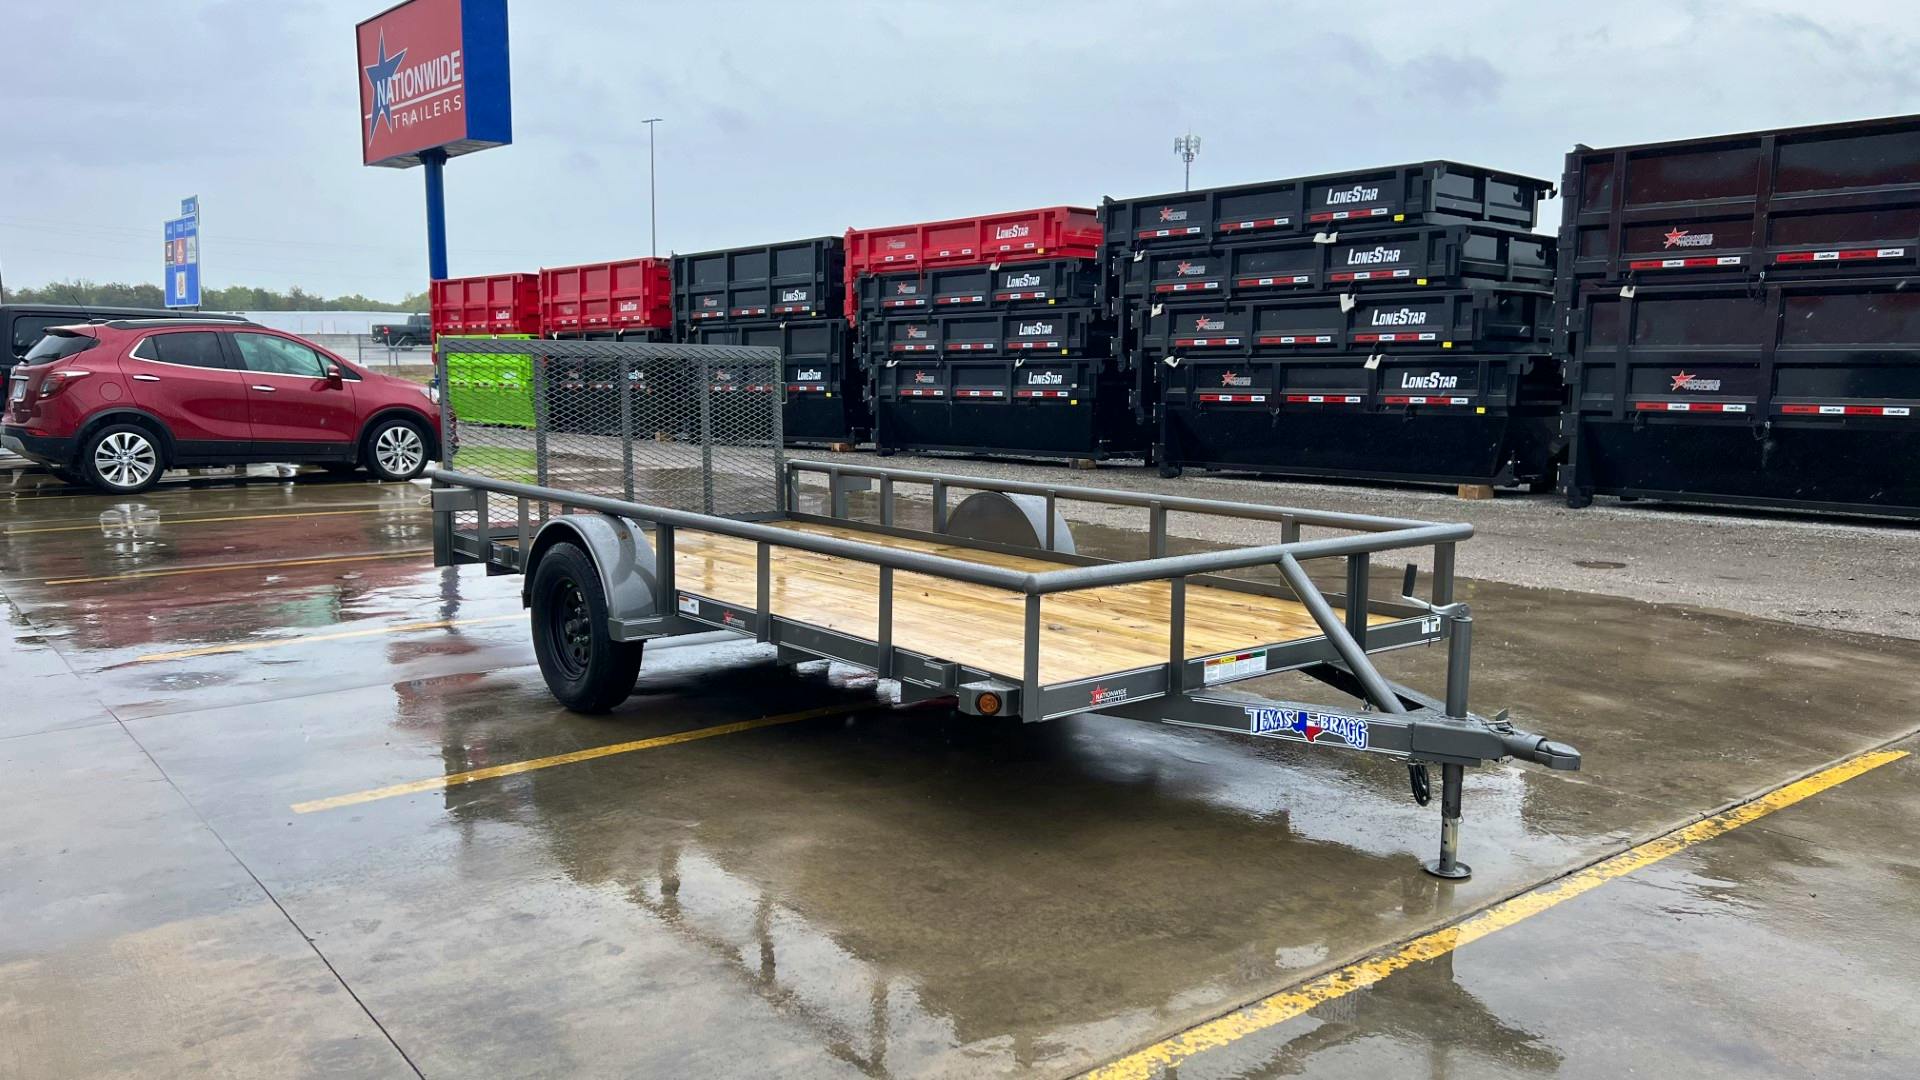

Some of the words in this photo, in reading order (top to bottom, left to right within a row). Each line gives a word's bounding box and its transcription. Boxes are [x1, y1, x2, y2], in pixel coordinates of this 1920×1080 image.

[376, 51, 461, 107] NATIONWIDE
[393, 95, 461, 128] TRAILERS
[1326, 186, 1379, 205] LONESTAR
[1347, 246, 1401, 265] LONESTAR
[1371, 307, 1427, 326] LONESTAR
[1401, 372, 1458, 389] LONESTAR
[1245, 707, 1296, 735] TEXAS
[1319, 714, 1370, 749] BRAGG
